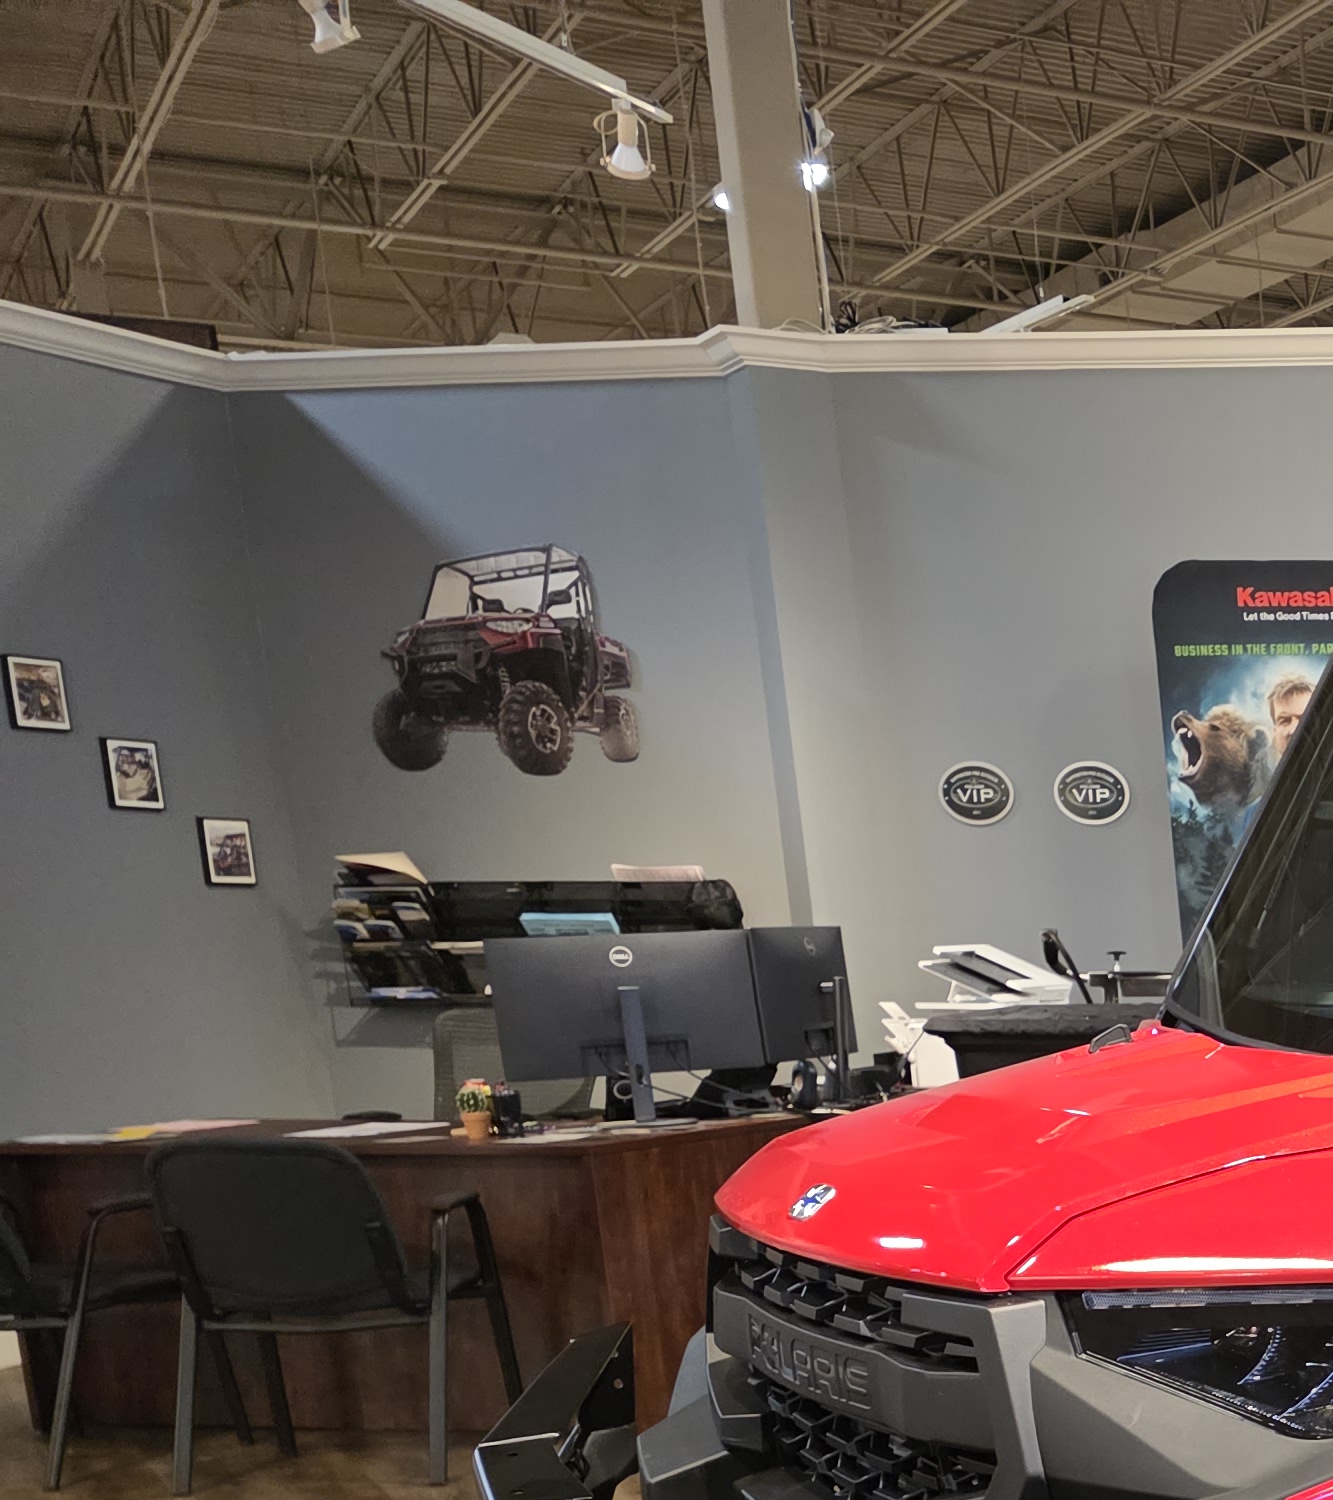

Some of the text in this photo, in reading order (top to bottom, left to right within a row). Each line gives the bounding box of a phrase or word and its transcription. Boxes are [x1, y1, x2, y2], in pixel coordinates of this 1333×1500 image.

[1243, 611, 1258, 621] Let
[1260, 611, 1275, 621] the
[1276, 611, 1301, 621] Good
[1301, 611, 1329, 621] Times
[1174, 645, 1229, 657] BUSINESS
[1231, 645, 1244, 656] IN
[1246, 644, 1268, 656] THE
[957, 788, 994, 803] VIP
[1072, 788, 1111, 803] VIP
